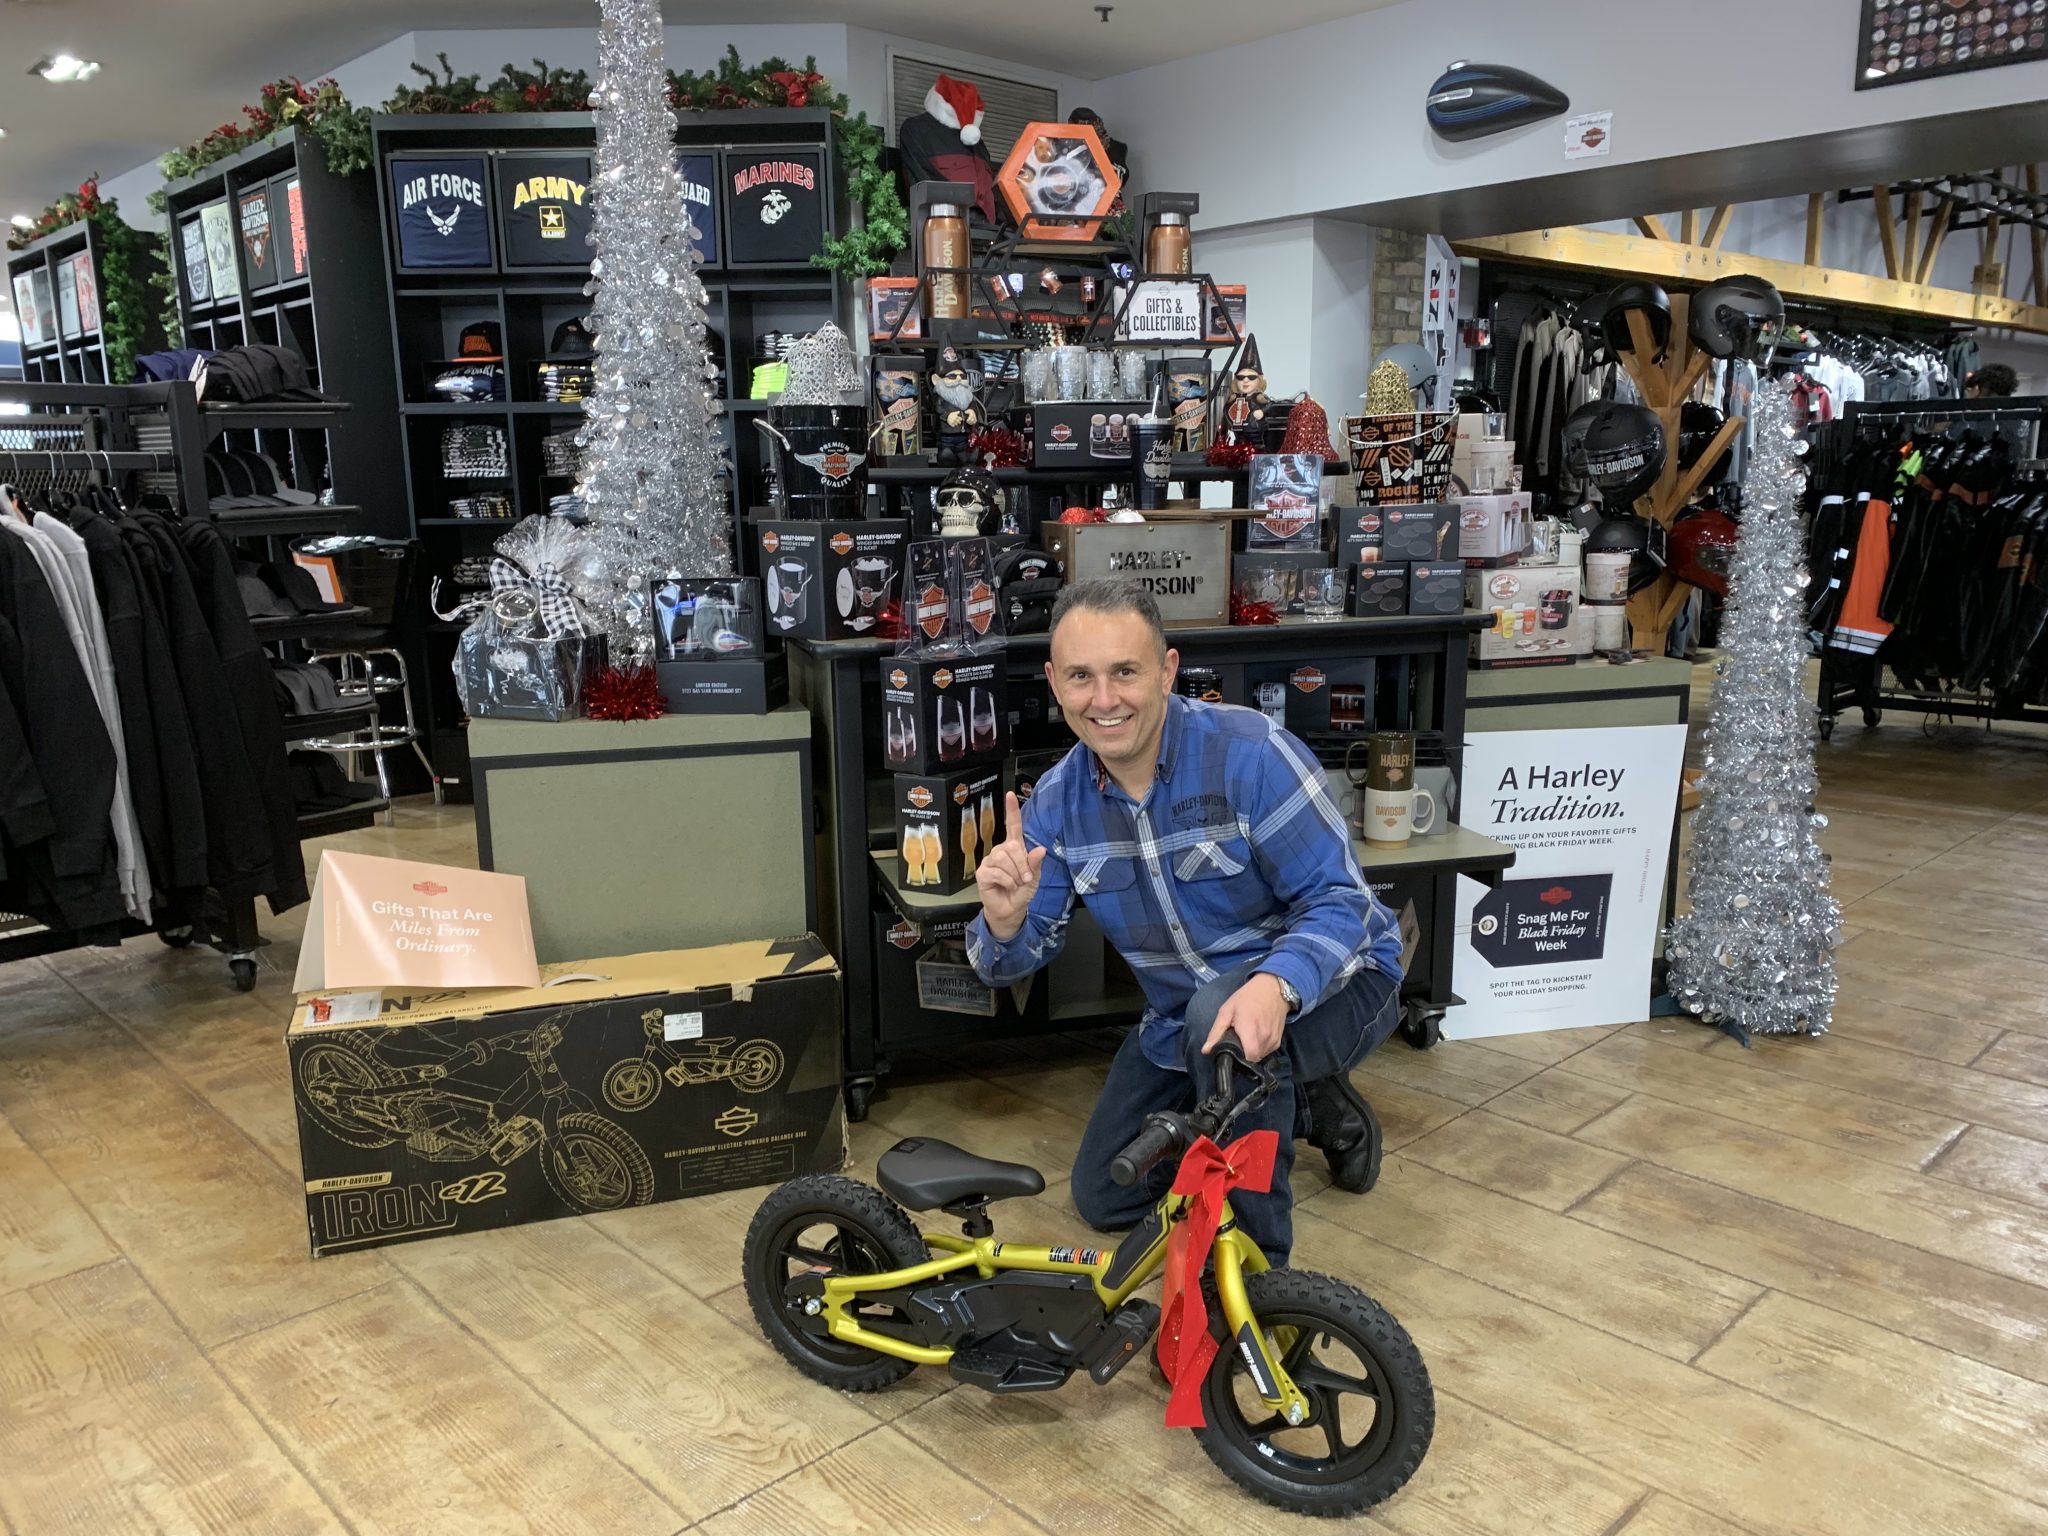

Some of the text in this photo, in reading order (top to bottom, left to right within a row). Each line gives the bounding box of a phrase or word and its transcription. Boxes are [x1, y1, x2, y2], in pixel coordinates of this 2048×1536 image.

[734, 162, 814, 195] MARINES
[403, 173, 484, 209] AIR FORCE
[514, 176, 586, 210] ARMY
[680, 181, 710, 206] UARD
[1146, 298, 1183, 314] GIFTS &
[1133, 315, 1196, 331] COLLECTIBLES
[1396, 421, 1413, 431] THE
[819, 442, 850, 452] PREMIUM
[821, 476, 852, 487] QUALITY
[1378, 485, 1419, 497] ROGUE
[1110, 550, 1191, 571] HARLEY-
[1380, 753, 1412, 767] HARLEY-
[1497, 764, 1626, 792] A Harley
[902, 808, 940, 816] HARLEY-DAVIDSON
[1375, 805, 1407, 817] DAVIDSON
[1491, 795, 1625, 824] Tradition.
[1518, 833, 1530, 841] UP
[1546, 830, 1569, 838] YOUR
[1571, 828, 1611, 837] FAVORITE
[1612, 827, 1637, 835] GIFTS
[1528, 841, 1556, 849] BLACK
[1557, 839, 1587, 847] FRIDAY
[372, 900, 493, 922] Gifts That Are
[1517, 910, 1590, 925] Snag Me For
[389, 919, 480, 937] Miles From
[1518, 924, 1586, 939] Black Friday
[396, 937, 476, 955] Ordinary.
[1535, 939, 1567, 951] Week
[1552, 974, 1592, 983] KICKSTART
[1515, 988, 1546, 996] HOLIDAY
[717, 1136, 769, 1151] ELECTRIC-POWERED
[770, 1132, 794, 1142] BALANCE
[795, 1130, 807, 1138] BIKE
[322, 1174, 385, 1188] HARLEY-DAVIDSON
[323, 1180, 448, 1240] IRON
[1240, 1342, 1268, 1395] HARLEY-DAVIDSON
